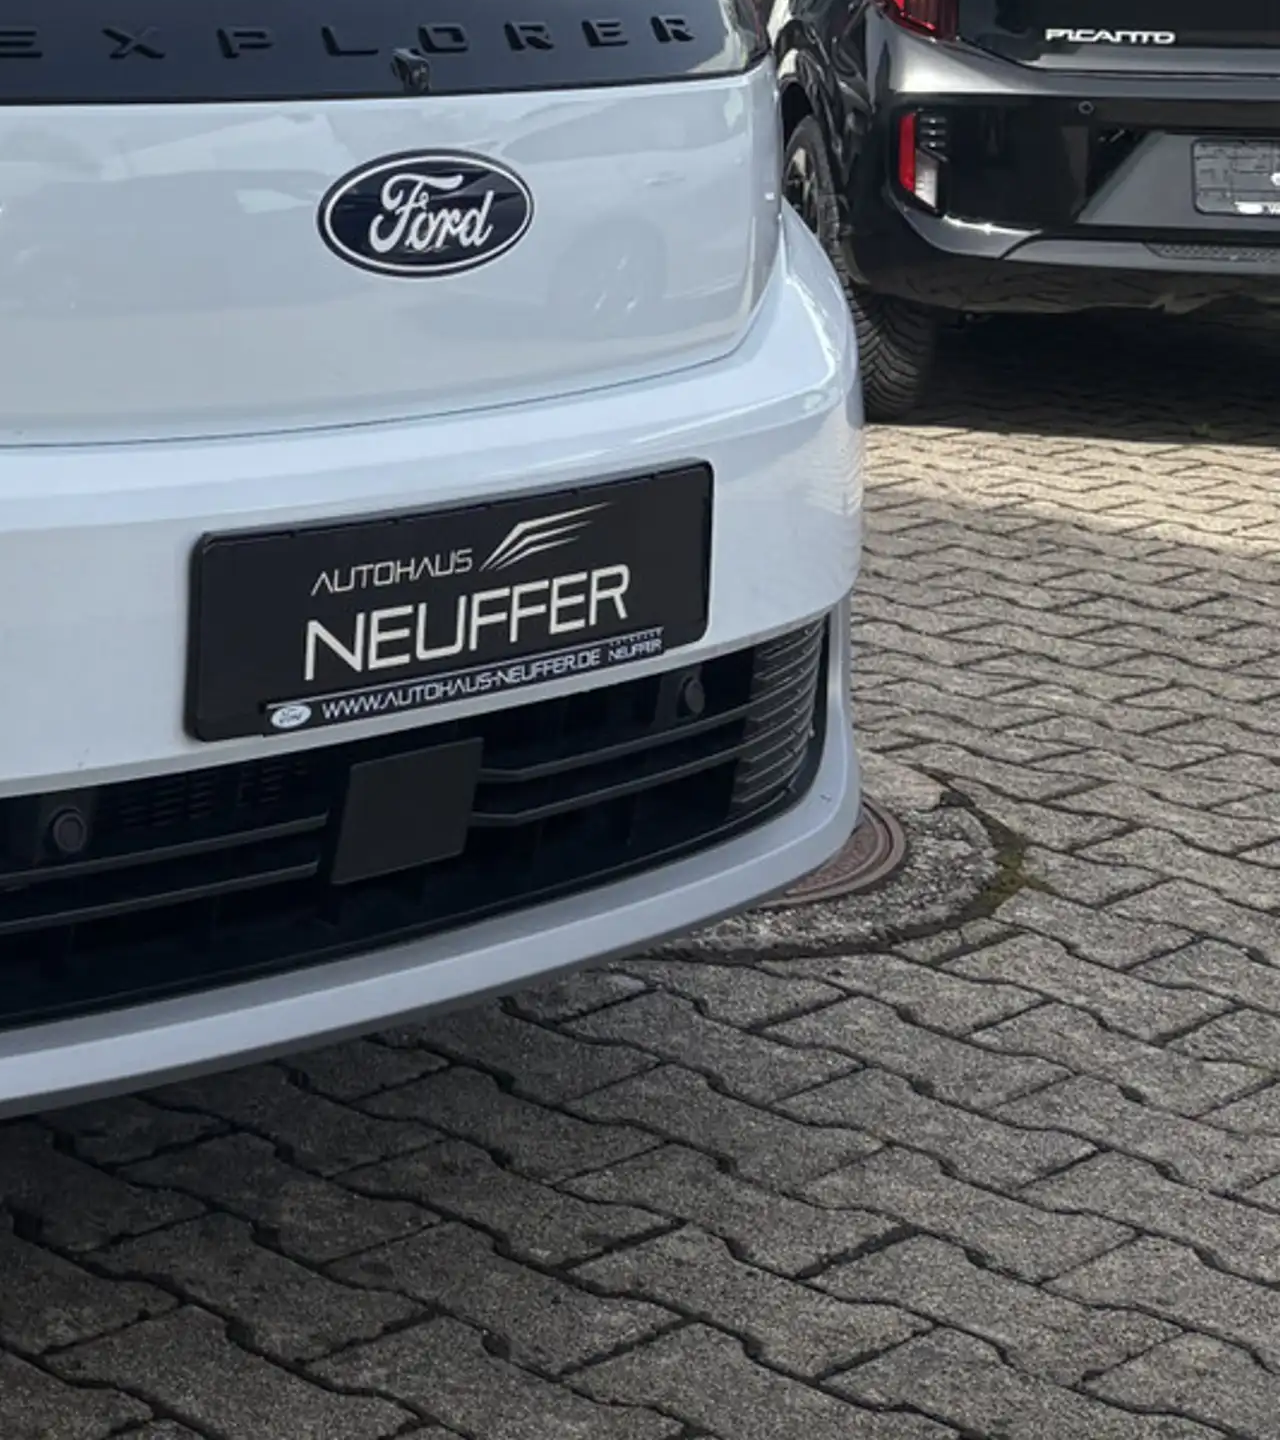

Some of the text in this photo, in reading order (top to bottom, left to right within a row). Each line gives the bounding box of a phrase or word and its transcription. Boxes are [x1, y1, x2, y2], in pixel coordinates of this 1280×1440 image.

[1045, 28, 1176, 44] PICANTO
[368, 171, 493, 254] Ford
[310, 548, 474, 596] AUTOHAUS
[304, 563, 629, 681] NEUFFER
[321, 647, 601, 719] WWW.AUTOHAUS-NEUFFER.DE
